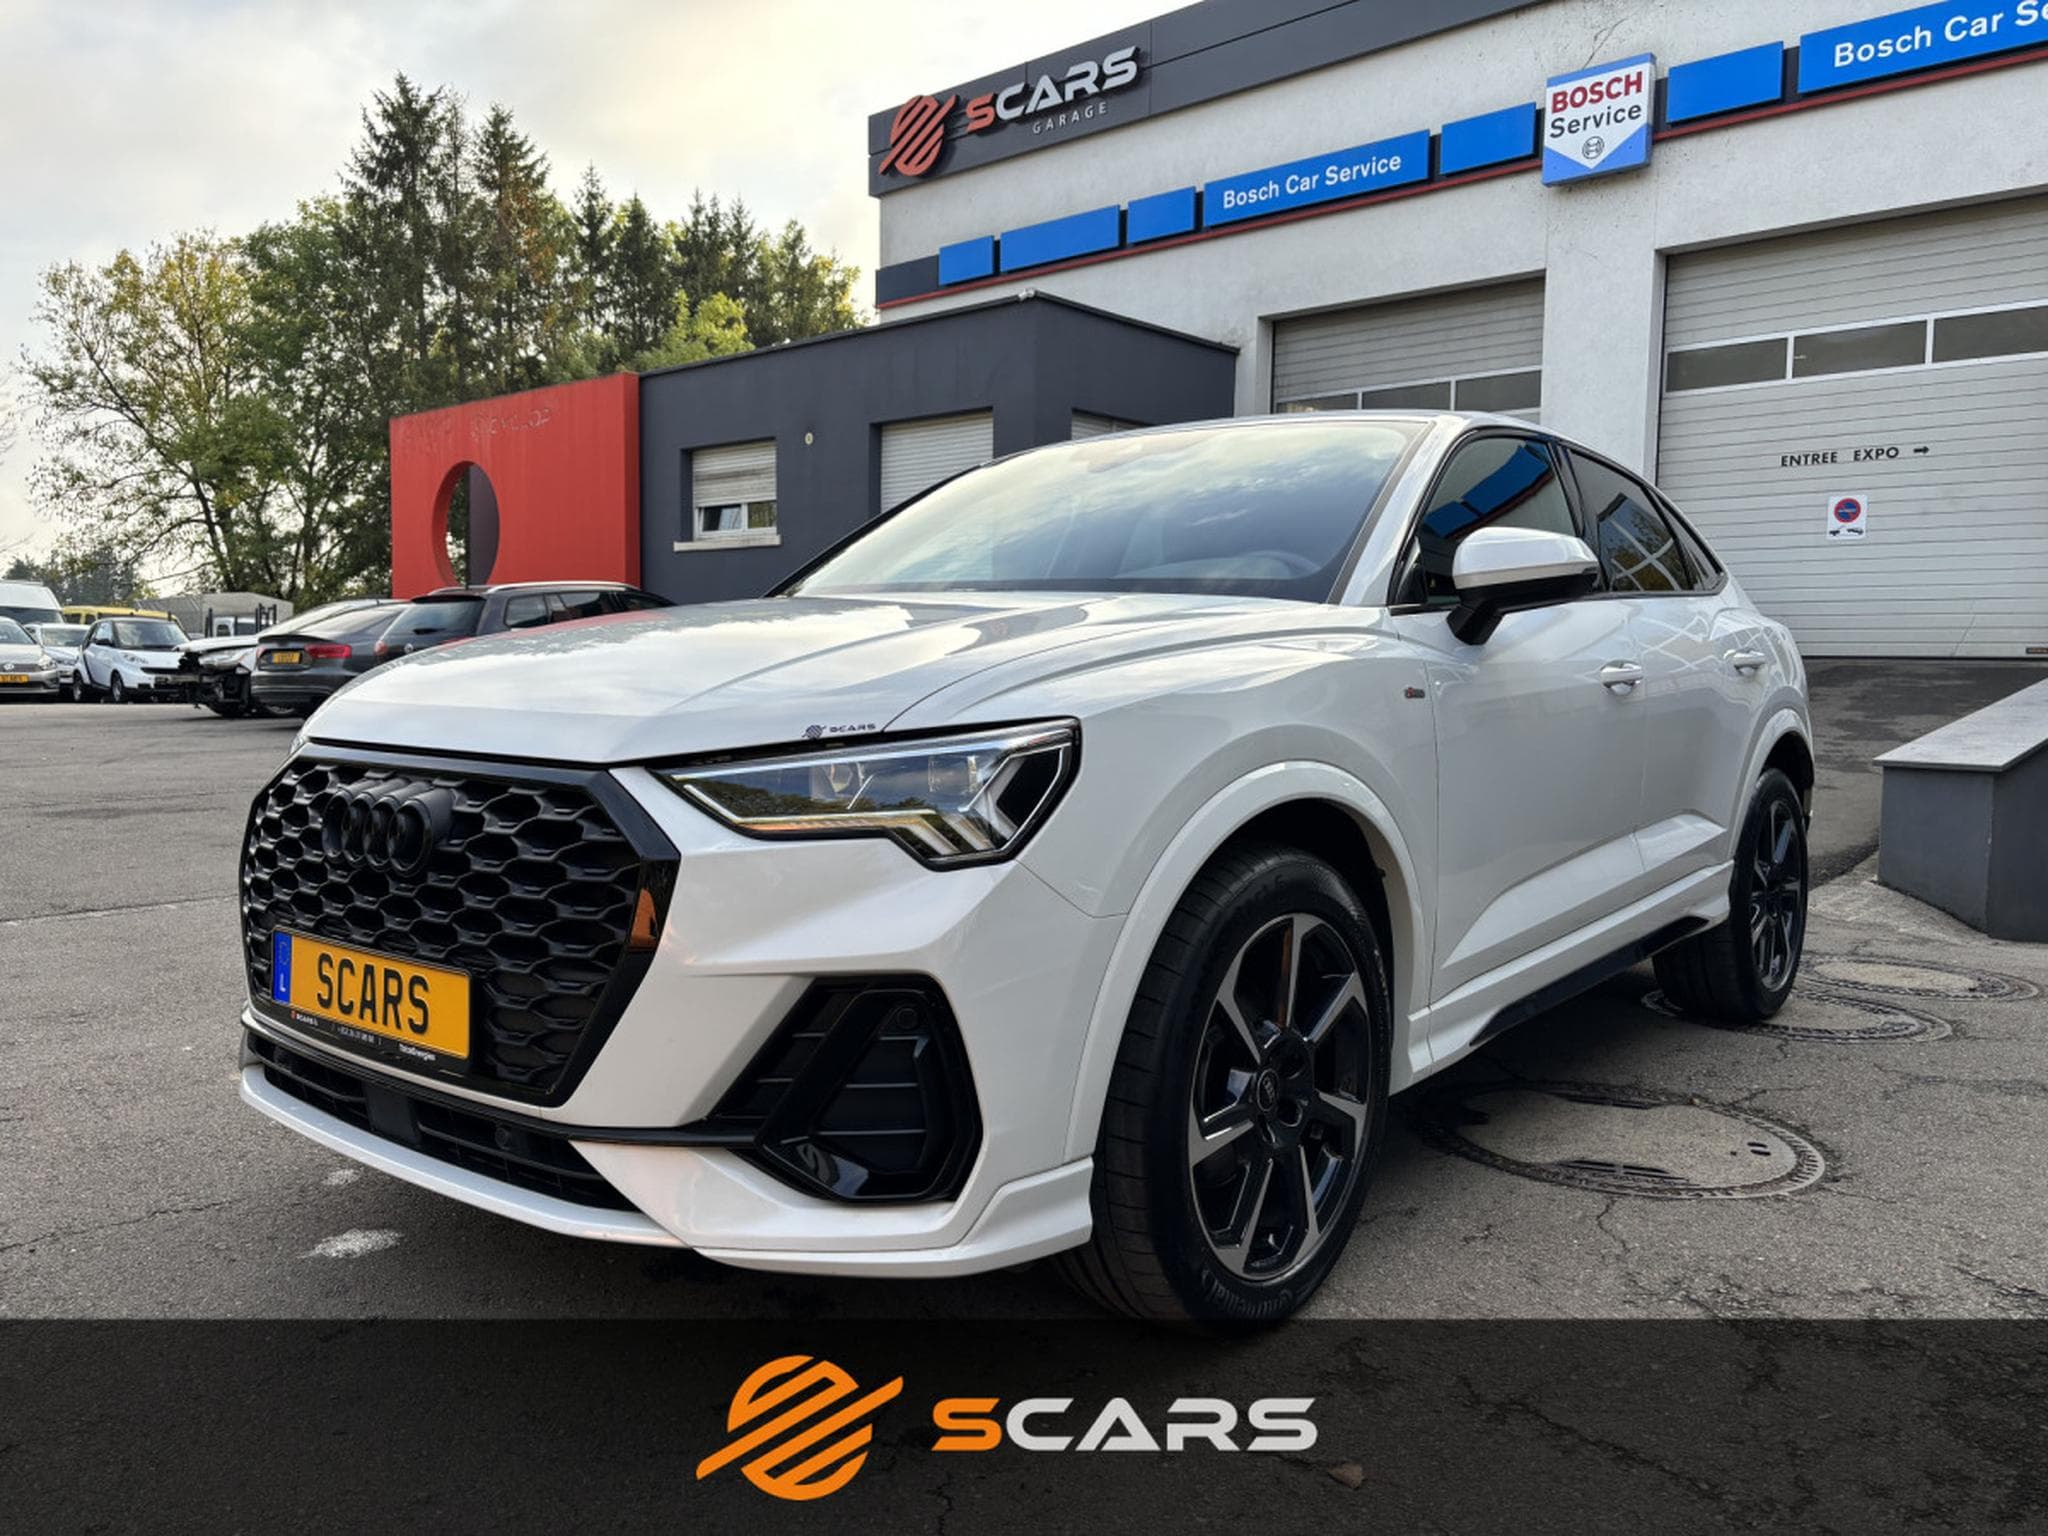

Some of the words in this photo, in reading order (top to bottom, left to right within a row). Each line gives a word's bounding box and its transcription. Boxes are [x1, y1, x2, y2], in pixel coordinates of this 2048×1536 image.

[1834, 25, 1932, 68] Bosch
[1944, 12, 2005, 42] Car
[966, 46, 1140, 133] SCARS
[1552, 71, 1642, 113] BOSCH
[1033, 102, 1108, 135] GARAGE
[1549, 104, 1642, 139] Service
[1223, 181, 1280, 208] Bosch
[1286, 175, 1319, 194] Car
[1325, 155, 1402, 186] Service
[1781, 452, 1838, 467] ENTREE
[1854, 447, 1899, 461] EXPO
[316, 952, 429, 1035] SCARS
